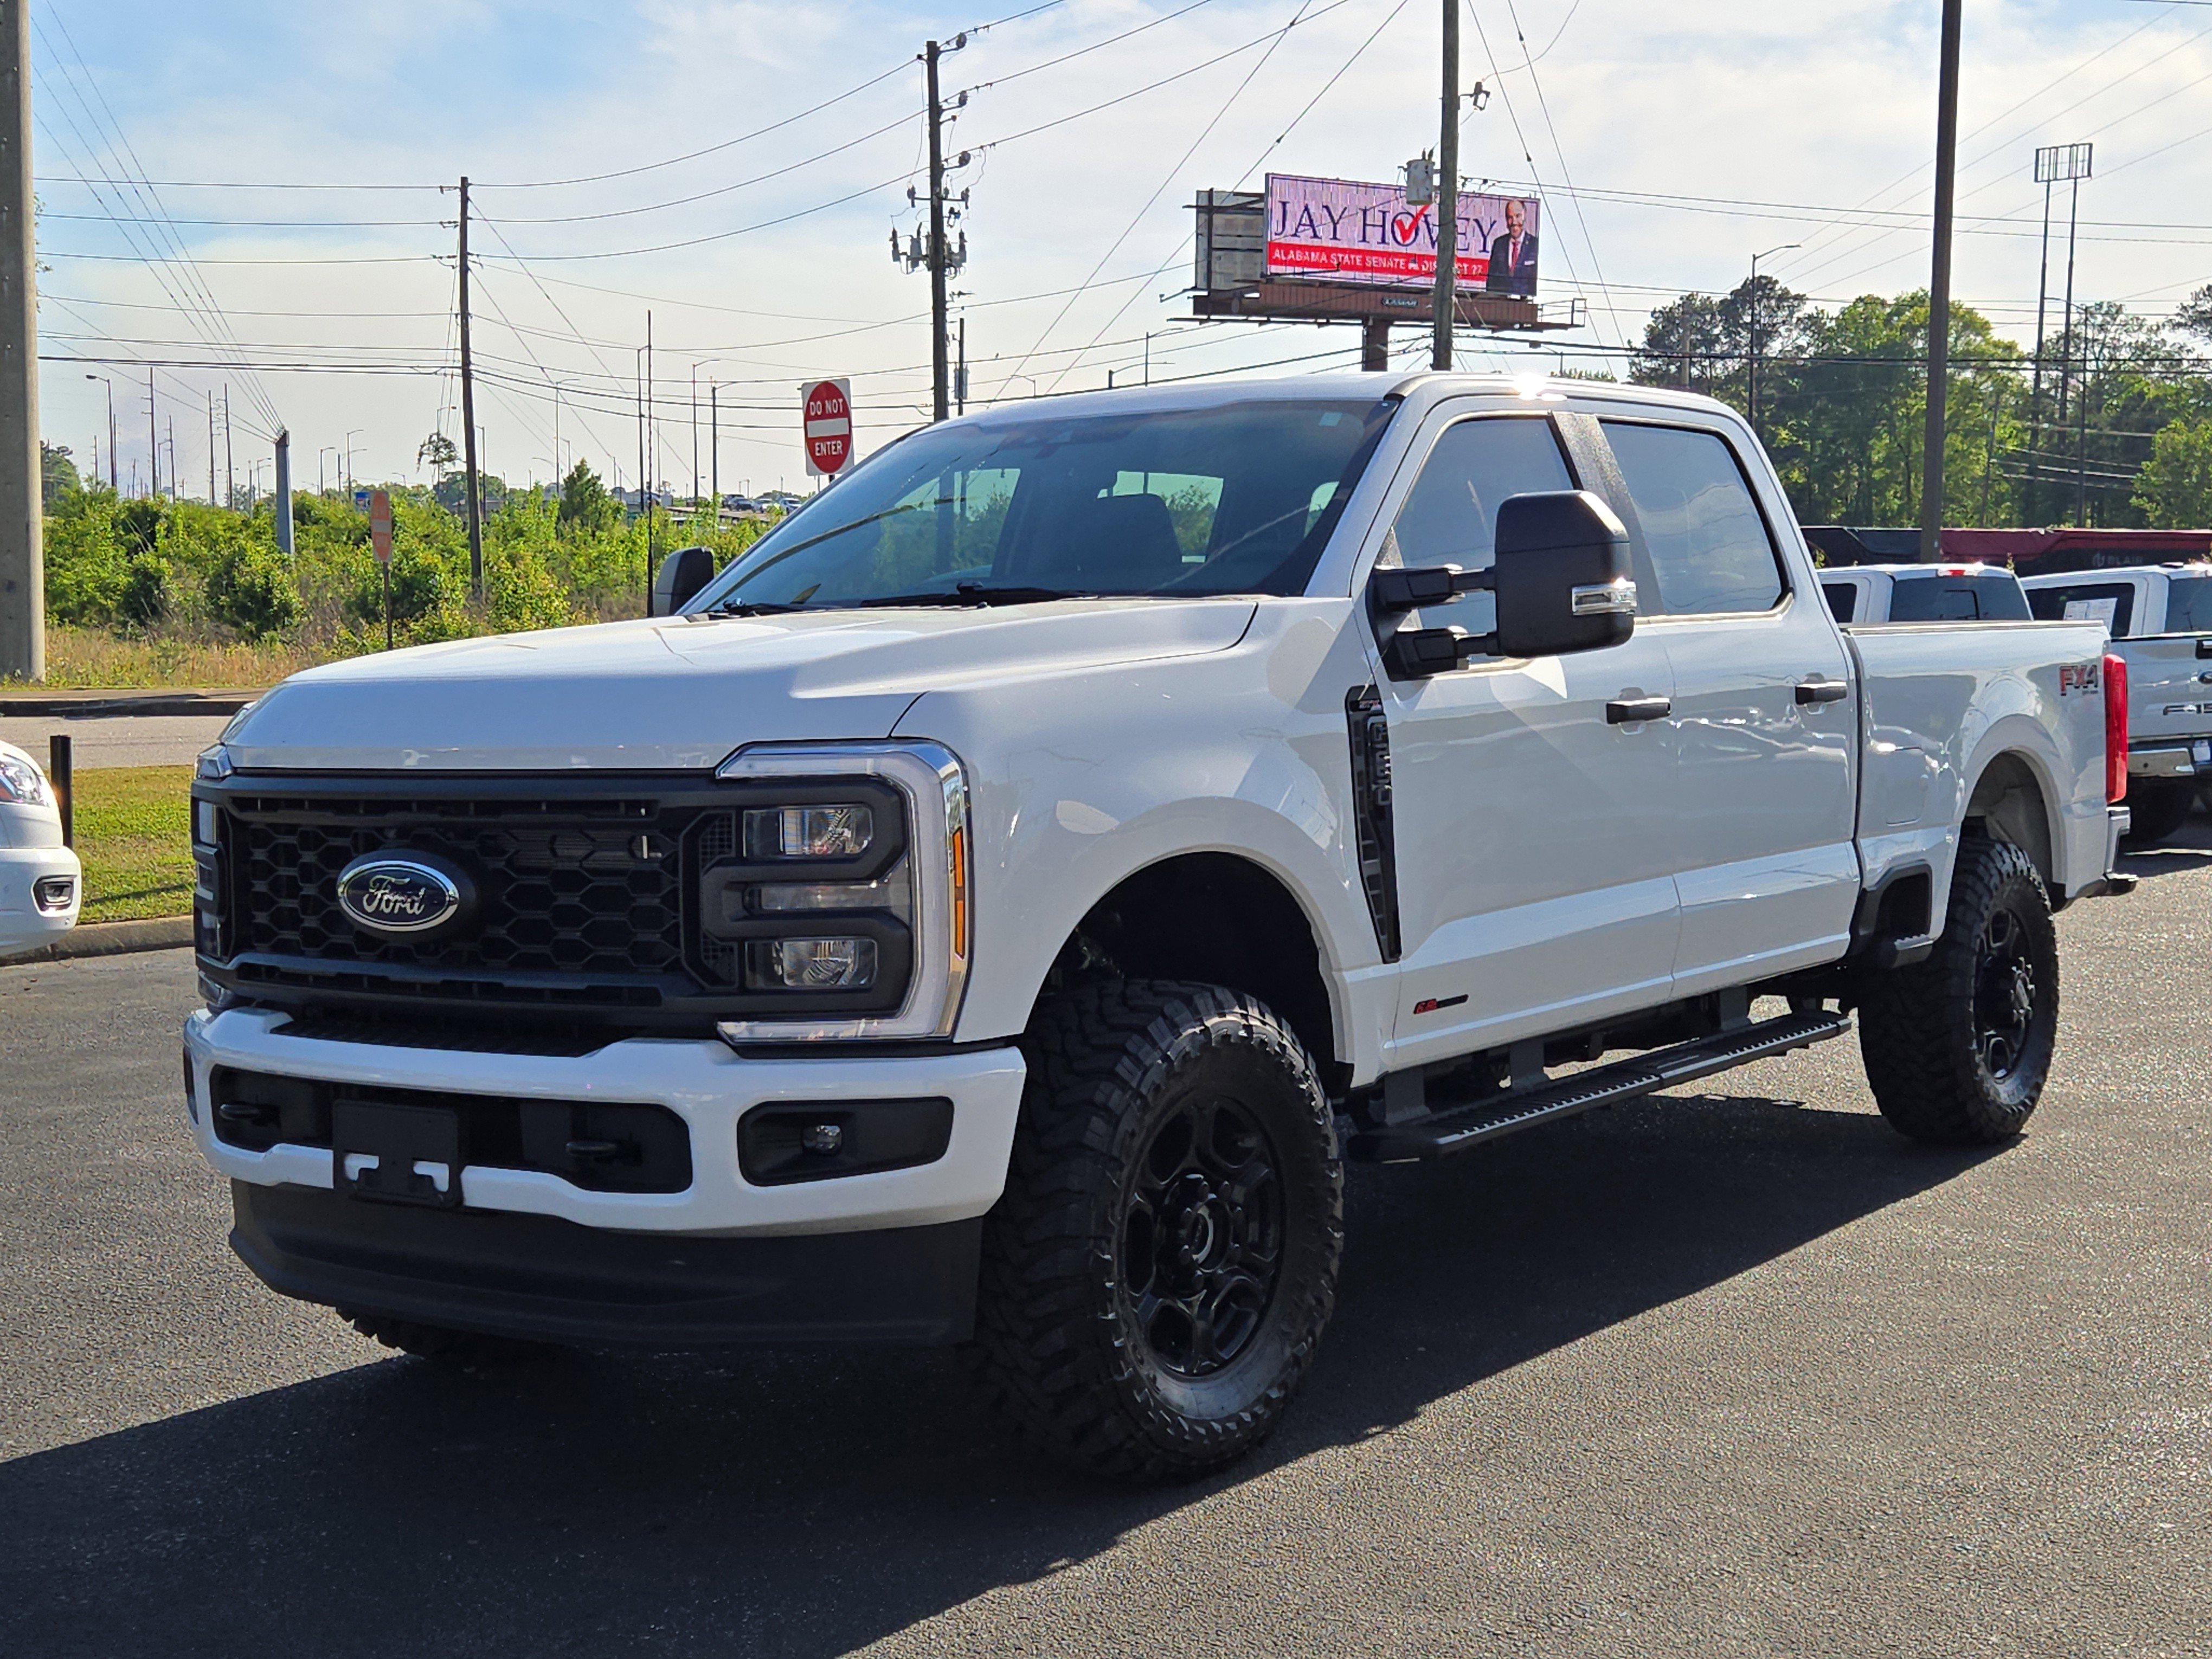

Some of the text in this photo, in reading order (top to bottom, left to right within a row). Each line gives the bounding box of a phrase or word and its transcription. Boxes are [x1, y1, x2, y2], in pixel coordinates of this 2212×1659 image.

[1275, 201, 1347, 241] JAY
[1272, 248, 1328, 264] ALABAMA
[1330, 253, 1362, 266] STATE
[1365, 255, 1406, 269] SENATE
[1422, 260, 1468, 275] DISCT
[809, 398, 843, 416] DO NOT
[815, 440, 843, 456] ENTER
[2059, 664, 2098, 696] FX4
[363, 874, 426, 915] Ford
